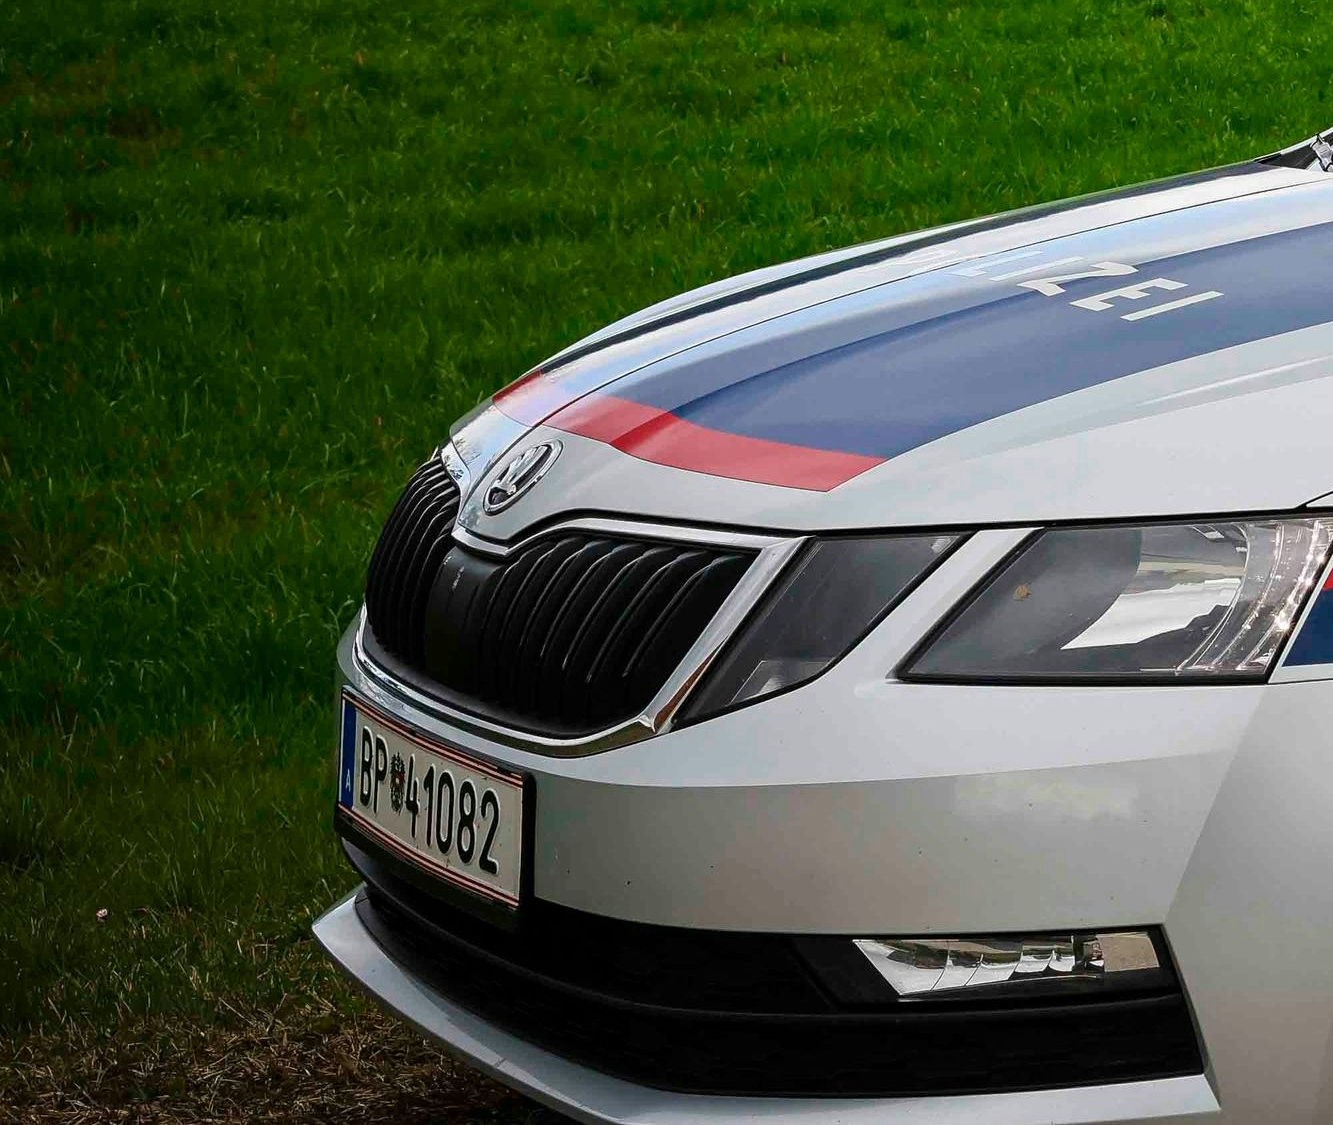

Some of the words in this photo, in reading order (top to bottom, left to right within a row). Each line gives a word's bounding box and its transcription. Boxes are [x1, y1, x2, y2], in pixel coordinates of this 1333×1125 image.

[344, 768, 351, 793] A
[360, 726, 388, 815] BP
[405, 754, 499, 875] 41082
